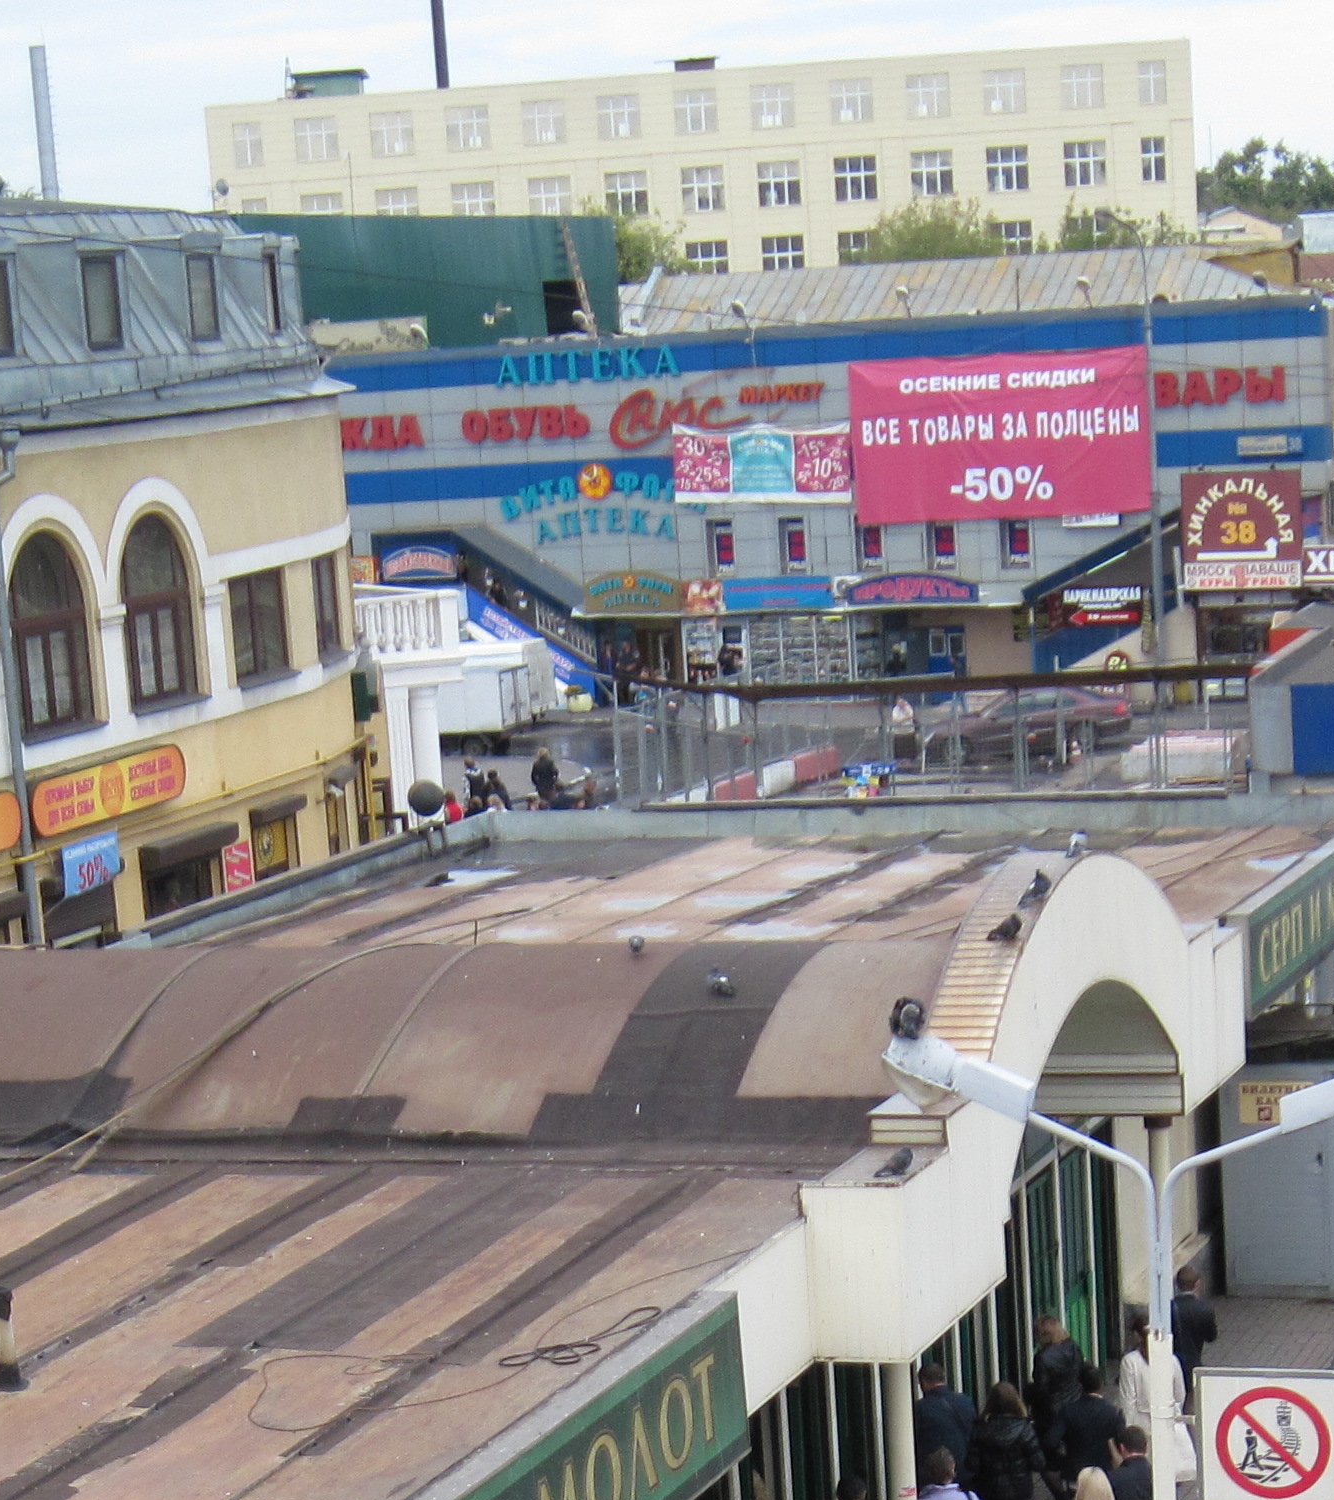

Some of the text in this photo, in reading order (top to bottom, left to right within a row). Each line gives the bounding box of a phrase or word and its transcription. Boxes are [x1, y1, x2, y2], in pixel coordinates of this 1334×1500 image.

[497, 345, 681, 387] АПТЕКА
[898, 366, 1095, 394] ОСЕННИЕ СКИДКИ
[738, 381, 825, 404] МАРКЕТ
[1153, 365, 1287, 408] ВАРЫ
[461, 404, 591, 444] ОБУВЬ
[861, 405, 1140, 446] ВСЕ ТОВАРЫ ЗА ПОЛЦЕНЫ
[949, 466, 1054, 502] -50%
[538, 507, 675, 544] АПТЕКА
[1187, 477, 1295, 546] ХИНКАЛЬНАЯ
[1220, 520, 1257, 545] 38
[1187, 563, 1224, 576] МЯСО
[853, 577, 970, 601] ПРОДУКТЫ
[78, 854, 110, 889] 50%
[1259, 903, 1303, 983] СЕРП
[1310, 889, 1321, 944] И
